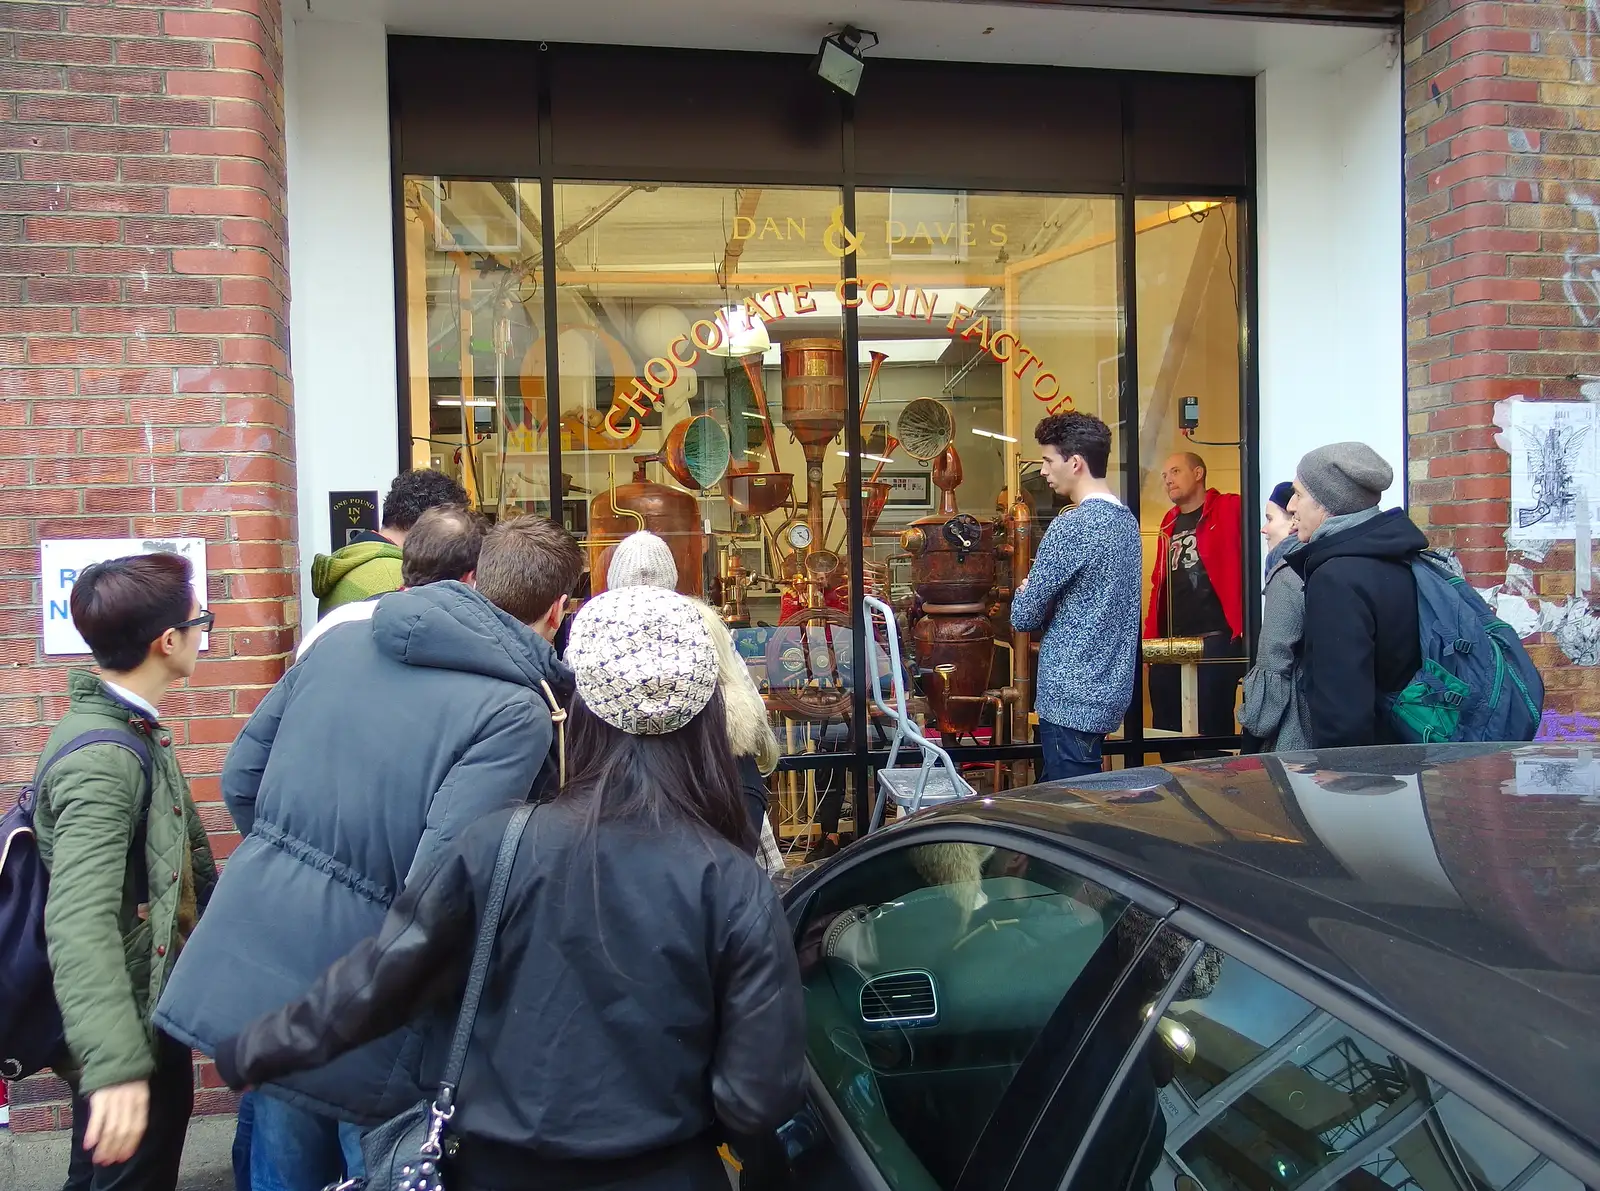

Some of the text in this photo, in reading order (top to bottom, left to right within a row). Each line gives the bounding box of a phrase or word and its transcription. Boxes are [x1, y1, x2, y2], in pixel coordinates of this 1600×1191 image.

[732, 205, 1009, 257] DAN & DAVE'S
[835, 277, 938, 322] COIN
[946, 301, 1077, 417] FACTOR
[333, 498, 375, 511] ONE POUND
[348, 507, 360, 515] IN
